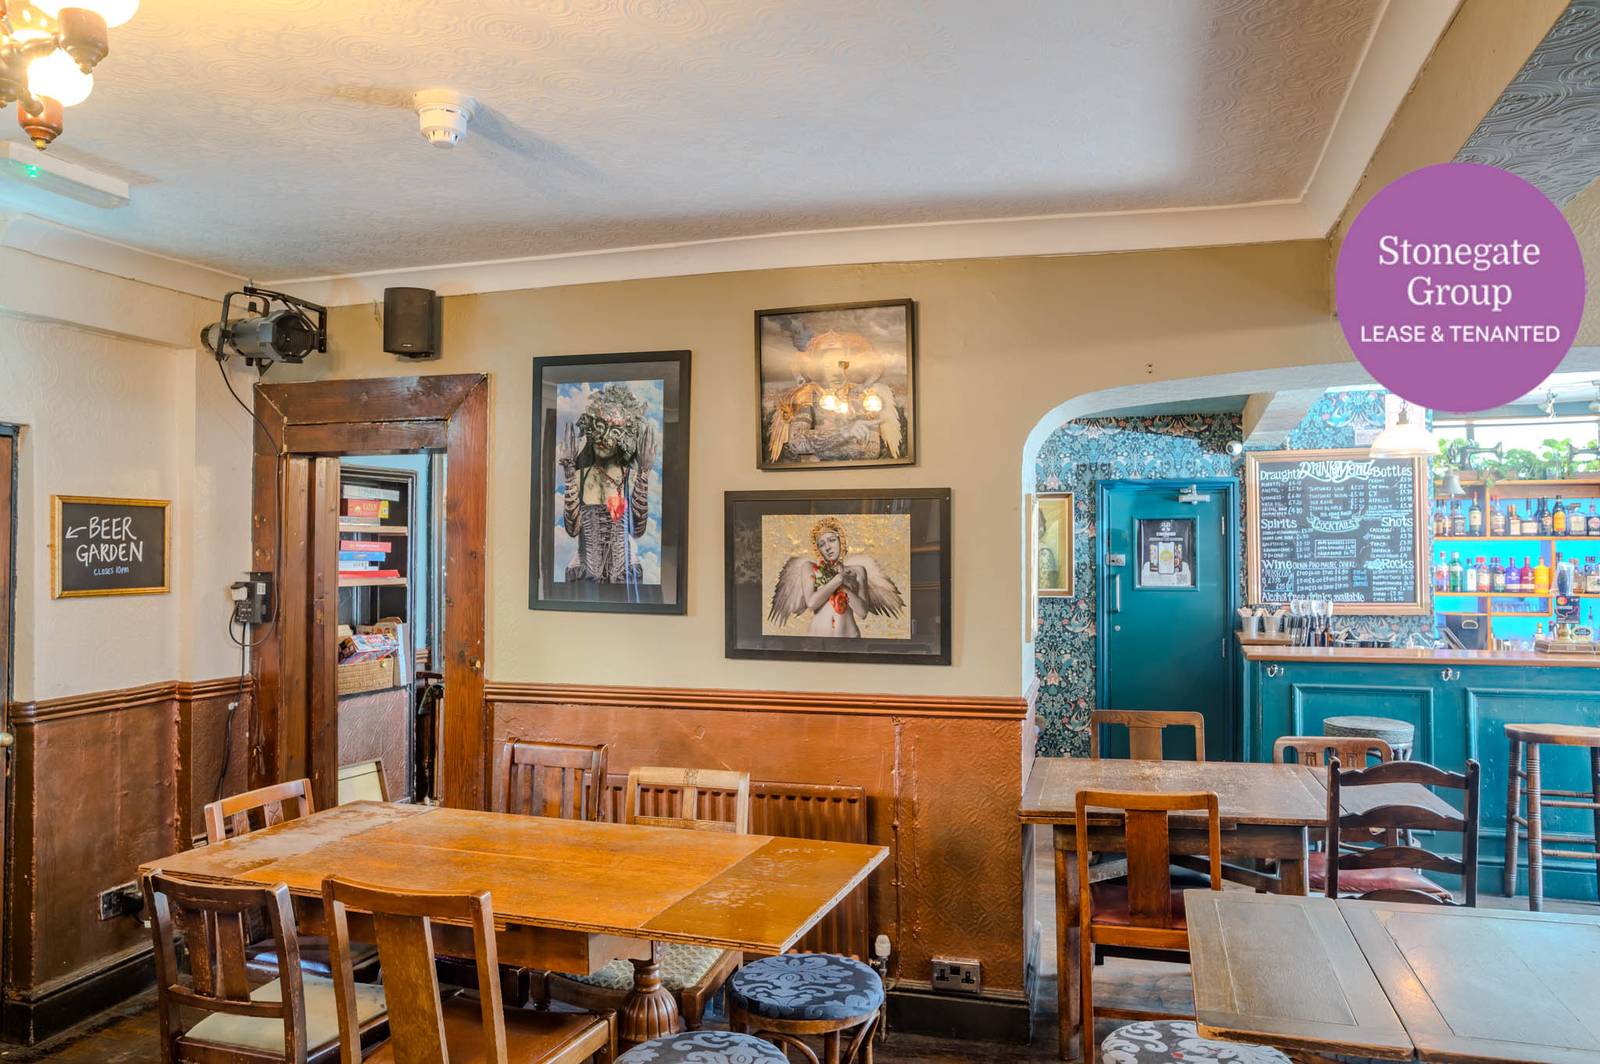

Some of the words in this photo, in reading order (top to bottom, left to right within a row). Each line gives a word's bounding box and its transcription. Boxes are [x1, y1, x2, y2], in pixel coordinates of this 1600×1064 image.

[1374, 465, 1413, 478] Bottles
[1260, 518, 1298, 530] Spirits
[1315, 519, 1355, 531] COCKTAILS
[1381, 516, 1414, 527] Shots
[89, 516, 137, 541] BEER
[76, 541, 144, 567] GARDEN
[1260, 559, 1293, 570] Wine
[1382, 559, 1415, 569] Rocks
[93, 567, 114, 577] CLOSES
